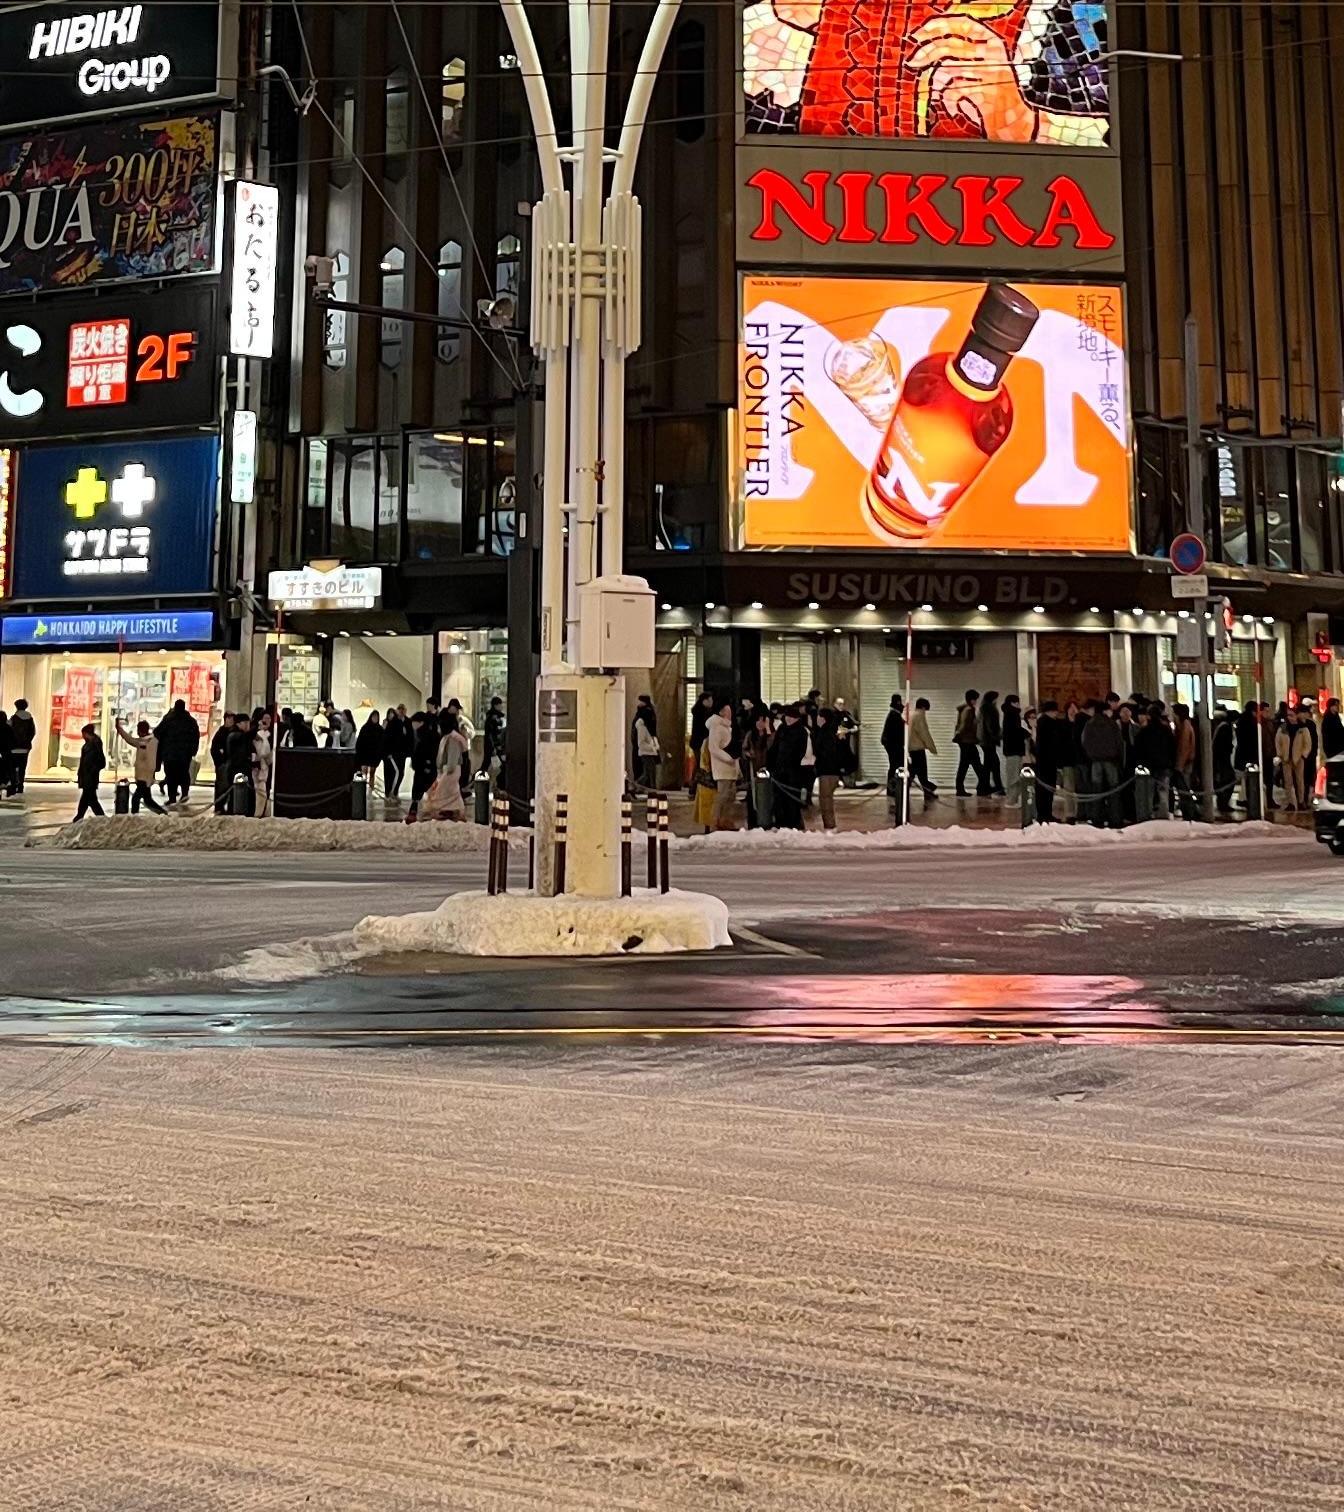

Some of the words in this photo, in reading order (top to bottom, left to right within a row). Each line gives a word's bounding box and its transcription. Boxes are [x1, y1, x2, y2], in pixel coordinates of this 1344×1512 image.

[29, 5, 143, 59] HIBIKI
[78, 55, 171, 95] Group
[99, 148, 199, 208] 300坪
[110, 212, 197, 256] 日本一
[746, 168, 1114, 250] NIKKA
[135, 332, 194, 382] 2F
[780, 323, 805, 437] NIKKA
[746, 323, 770, 497] FRONTIER
[286, 580, 364, 595] すすきのビル
[787, 573, 980, 604] SUSUKINO
[996, 576, 1078, 605] BLD.
[50, 621, 96, 637] HOKKAIDO
[99, 620, 129, 636] HAPPY
[130, 618, 179, 635] LIFESTYLE
